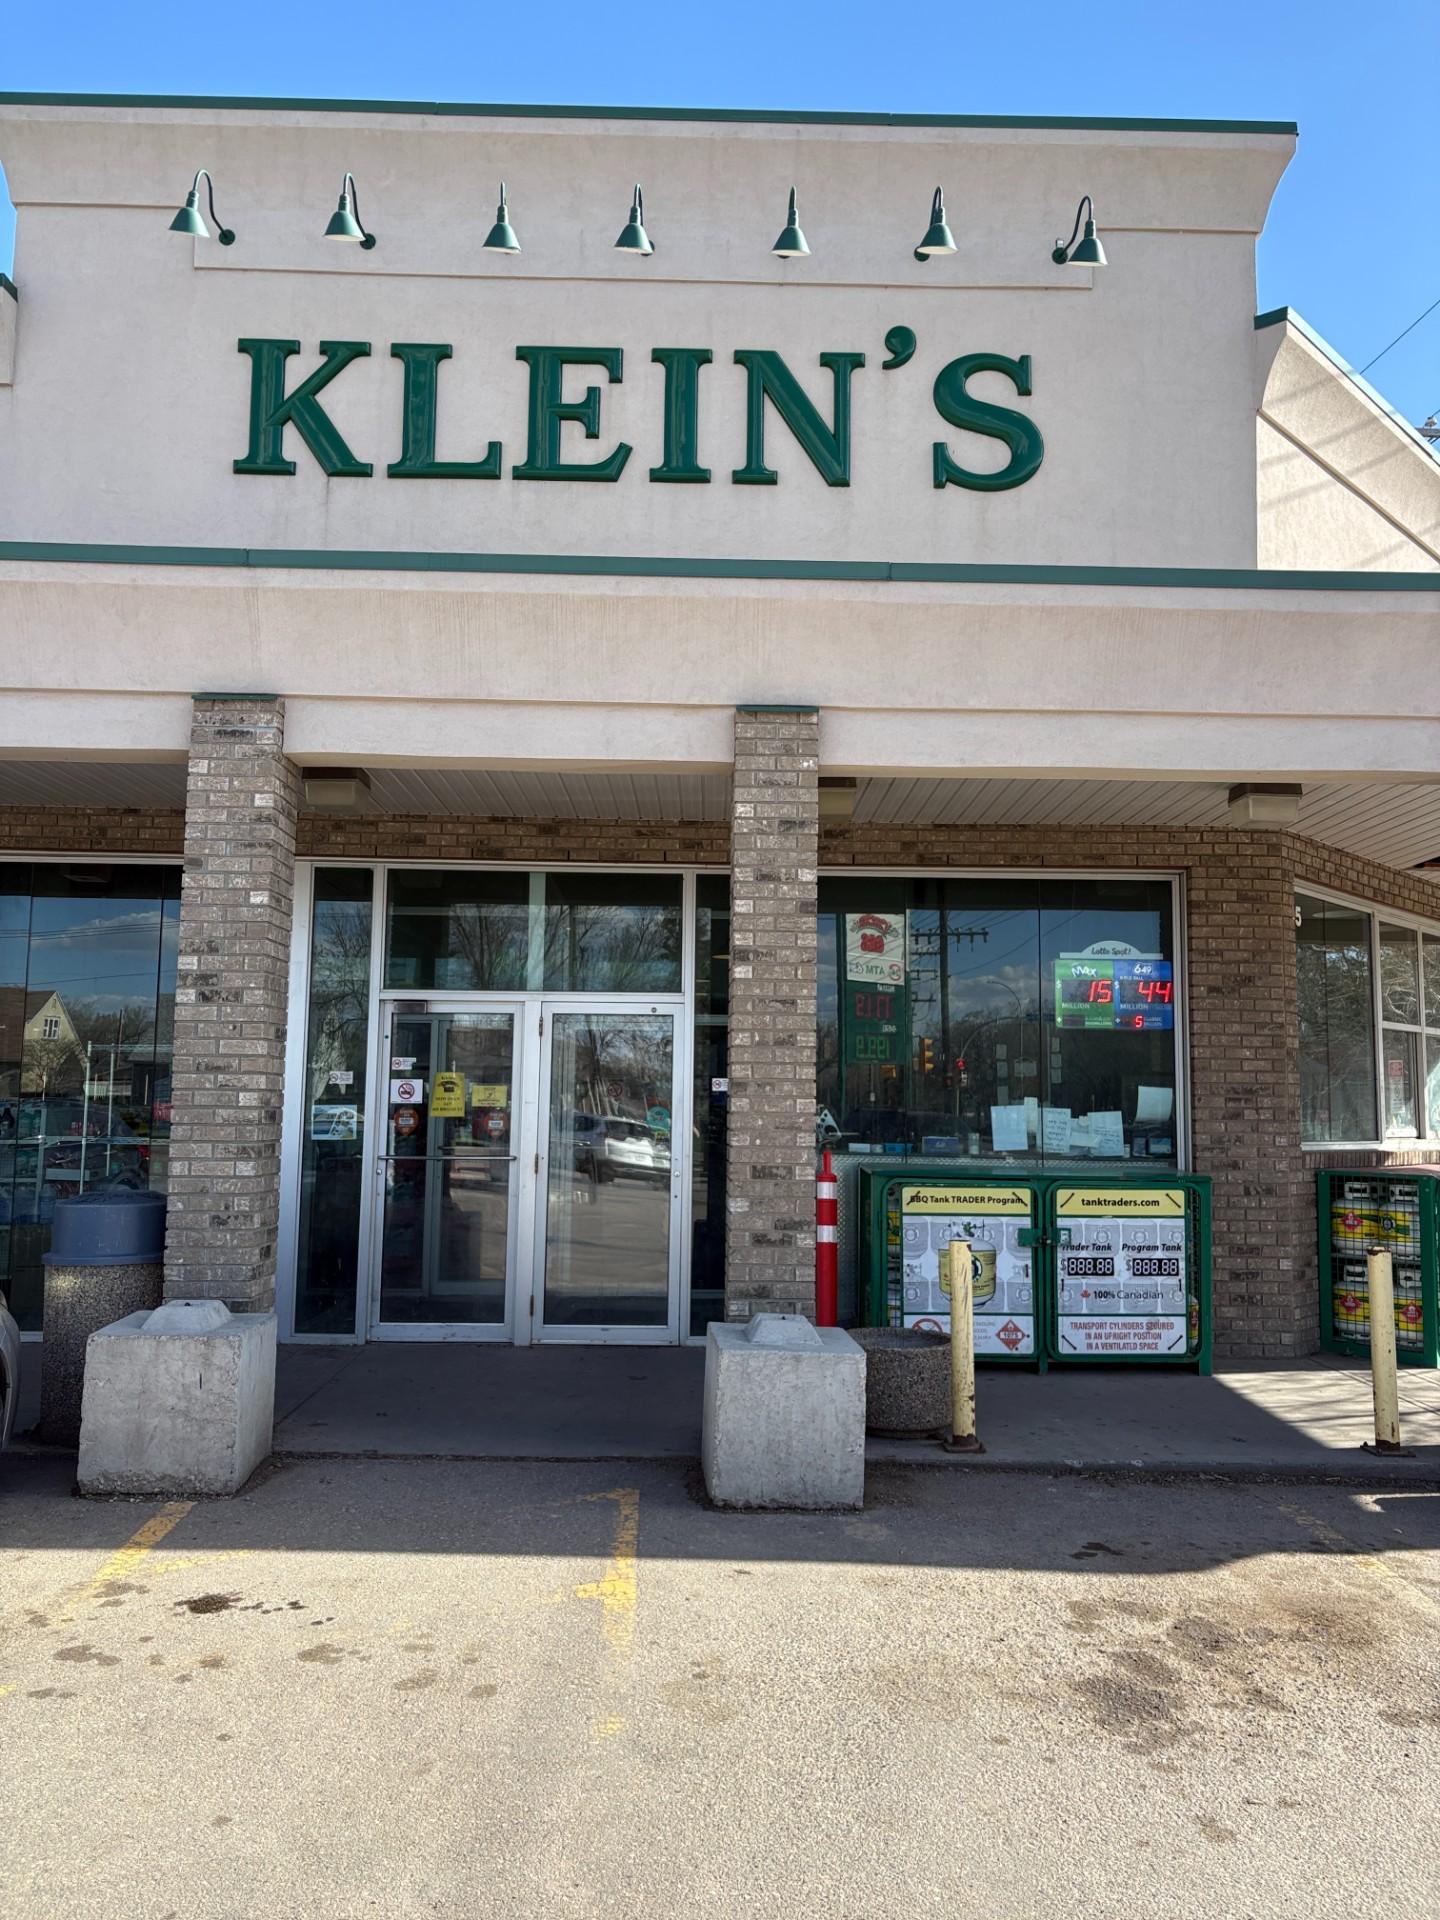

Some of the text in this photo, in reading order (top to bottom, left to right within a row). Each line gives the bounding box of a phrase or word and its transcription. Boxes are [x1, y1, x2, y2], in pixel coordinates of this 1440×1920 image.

[233, 325, 1044, 493] KLEIN'S
[1091, 947, 1110, 956] Lotto
[1088, 979, 1113, 1004] 15
[1137, 981, 1173, 1004] 44
[1135, 1015, 1145, 1028] 5
[930, 1194, 951, 1204] Tank
[951, 1195, 986, 1204] TRADER
[987, 1195, 1023, 1206] Program
[1081, 1197, 1161, 1208] tanktraders.com
[1061, 1243, 1113, 1252] Trader Tank
[1122, 1243, 1182, 1254] Program Tank
[1093, 1289, 1165, 1300] 100% Canadian
[1070, 1321, 1175, 1330] TRANSPORT CYLINDERS SECURED
[1085, 1331, 1162, 1341] IN AN UPRIGHT POSITION
[1086, 1342, 1159, 1351] IN A VENTILATED SPACE
